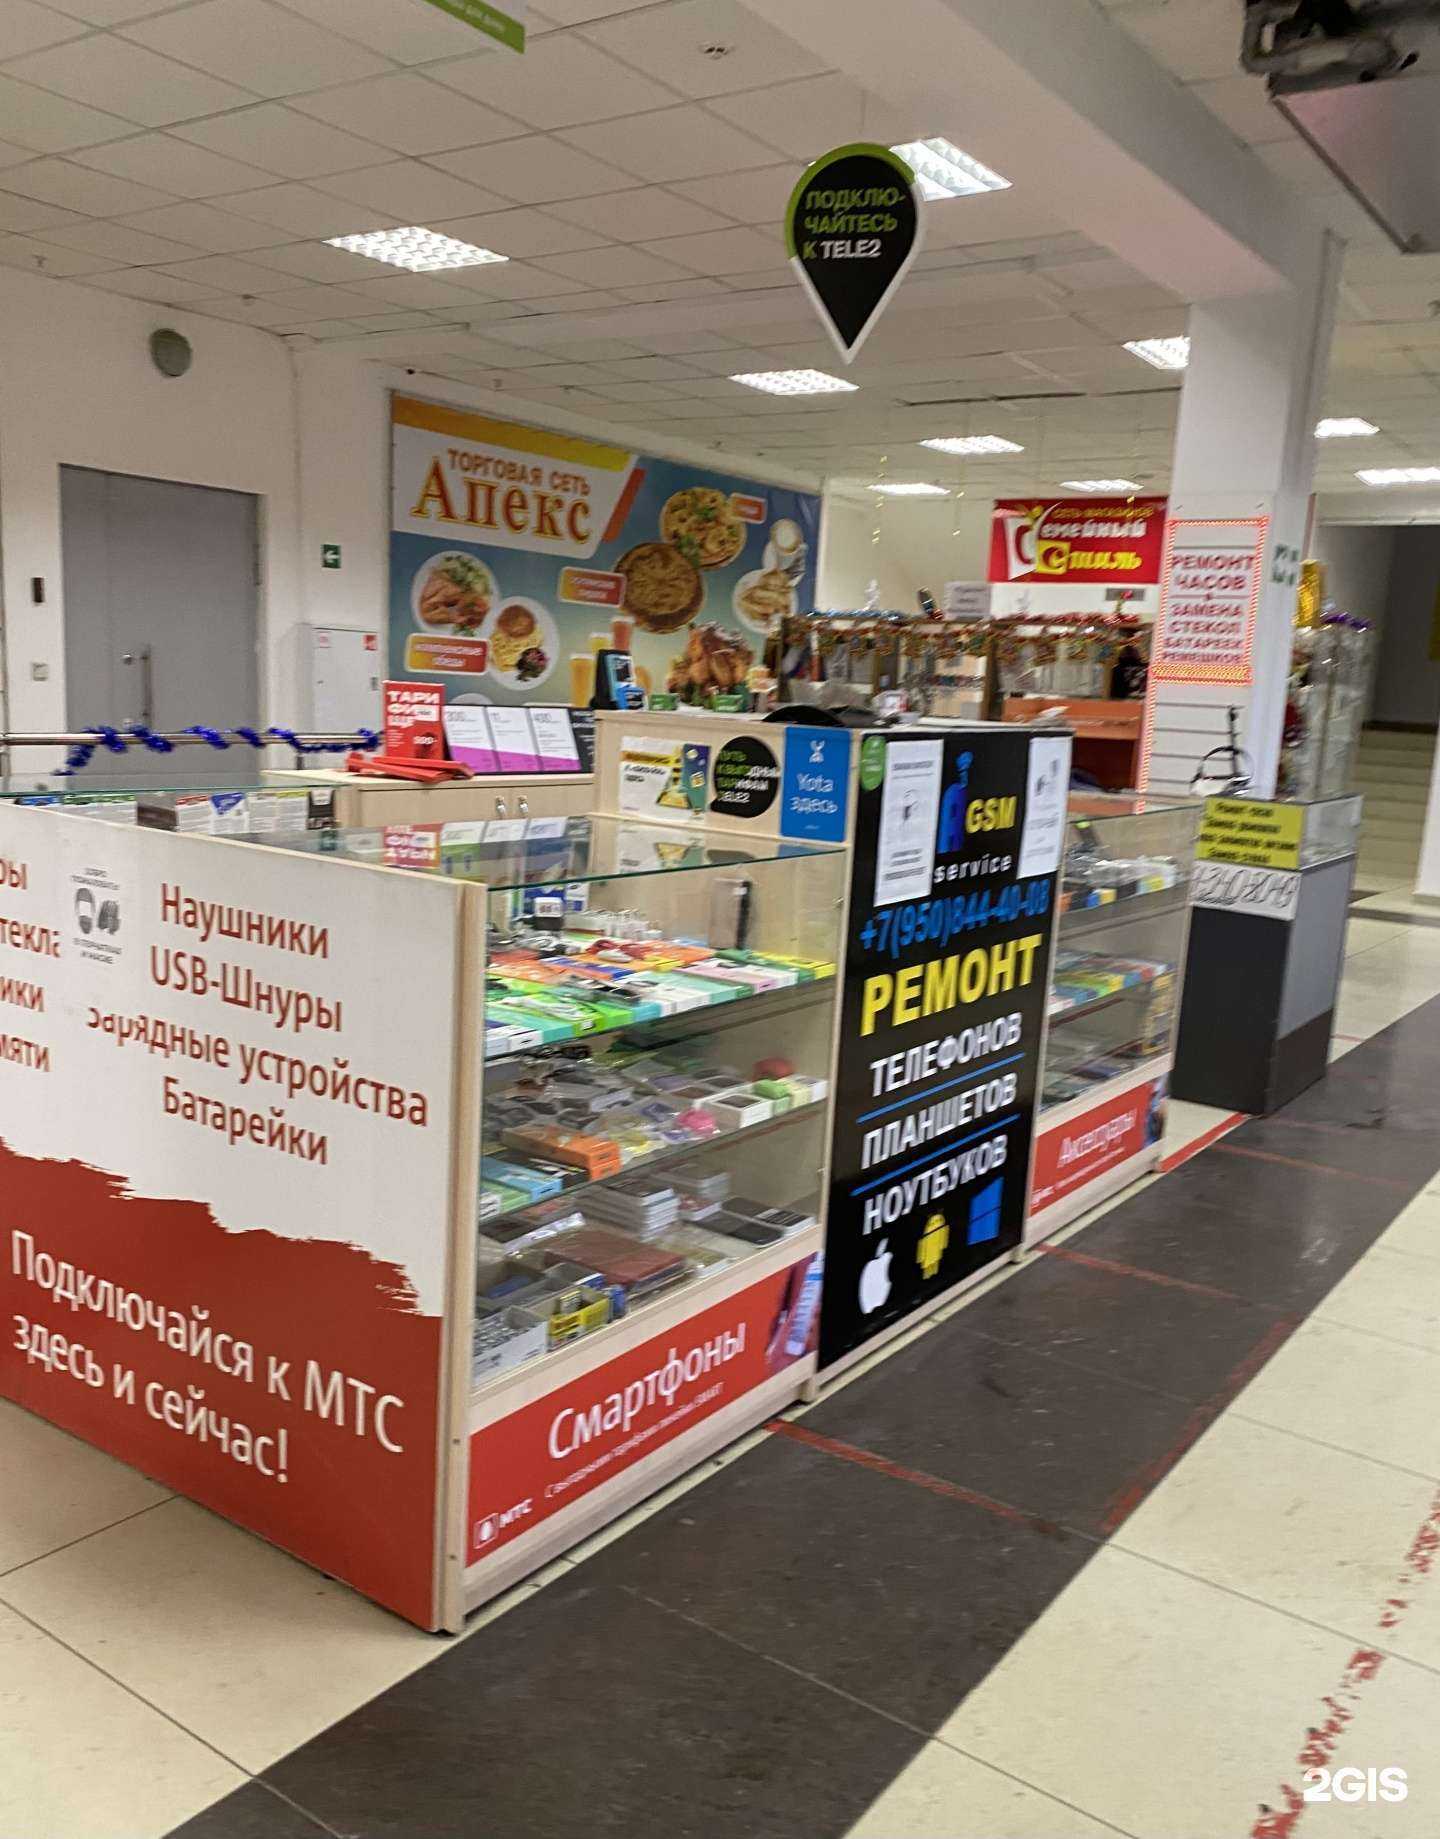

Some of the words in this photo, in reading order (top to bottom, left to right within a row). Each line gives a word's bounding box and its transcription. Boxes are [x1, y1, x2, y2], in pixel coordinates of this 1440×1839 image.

[804, 187, 906, 212] ПОДКЛЮ-
[804, 211, 898, 234] ЧАЙТЕСЬ
[802, 241, 817, 260] К
[819, 238, 883, 259] TELE2
[410, 456, 592, 545] Апекс
[446, 447, 545, 488] ТОРГОВАЯ
[550, 470, 591, 497] СЕТЬ
[1172, 555, 1254, 570] РЕМОНТ
[1175, 575, 1246, 590] ЧАСОВ
[1169, 621, 1242, 635] СТЕКОЛ
[1170, 604, 1243, 618] ЗАМЕНА
[1164, 637, 1245, 650] БАТАРЕЕК
[797, 773, 834, 793] Yota
[965, 796, 1018, 834] GSM
[933, 853, 1012, 883] service
[162, 883, 329, 959] Наушники
[151, 946, 342, 1033] USB-Шнуры
[860, 933, 1042, 1037] РЕМОНТ
[239, 1043, 429, 1127] устройства
[870, 1012, 1023, 1097] ТЕЛЕФОНОВ
[163, 1076, 328, 1165] Батарейки
[862, 1072, 1017, 1170] ПЛАНШЕТОВ
[862, 1134, 1007, 1235] НОУТБУКОВ
[12, 1230, 254, 1383] Подключайся
[267, 1356, 291, 1401] к
[304, 1360, 404, 1453] МТС
[13, 1315, 104, 1388] здесь
[113, 1363, 134, 1405] и
[145, 1382, 288, 1483] сейчас!
[548, 1323, 746, 1459] Смартфоны
